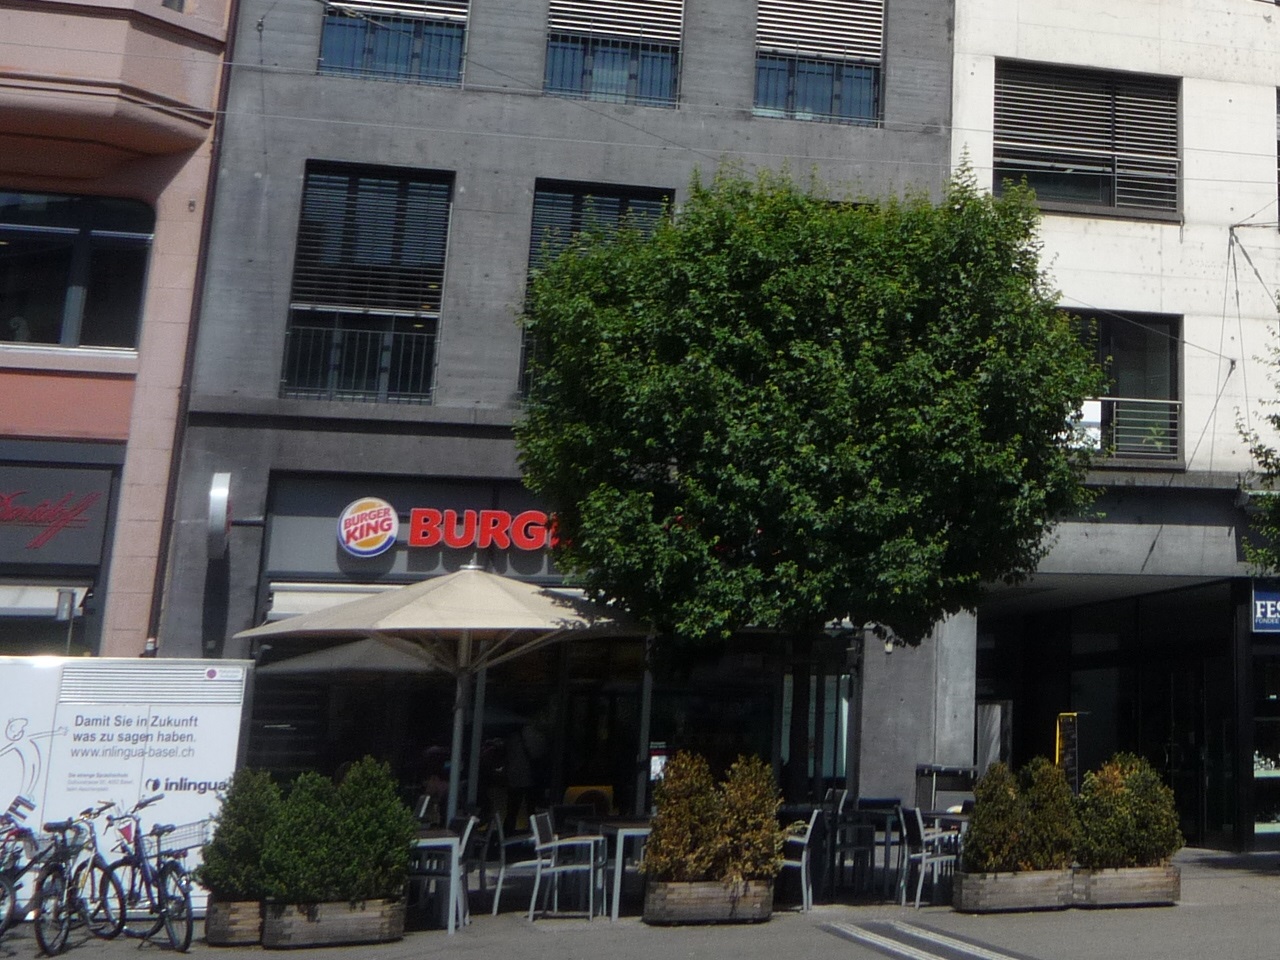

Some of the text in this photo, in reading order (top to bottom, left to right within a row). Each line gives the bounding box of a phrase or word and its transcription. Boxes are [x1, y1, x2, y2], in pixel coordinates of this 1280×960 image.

[343, 508, 392, 530] BURGER
[345, 517, 394, 546] KING
[75, 715, 199, 728] Damit Sie in Zukunft
[73, 731, 197, 745] was zu sagen haben.
[70, 746, 195, 760] www.inlingua-basel.ch
[164, 778, 228, 795] inlingua
